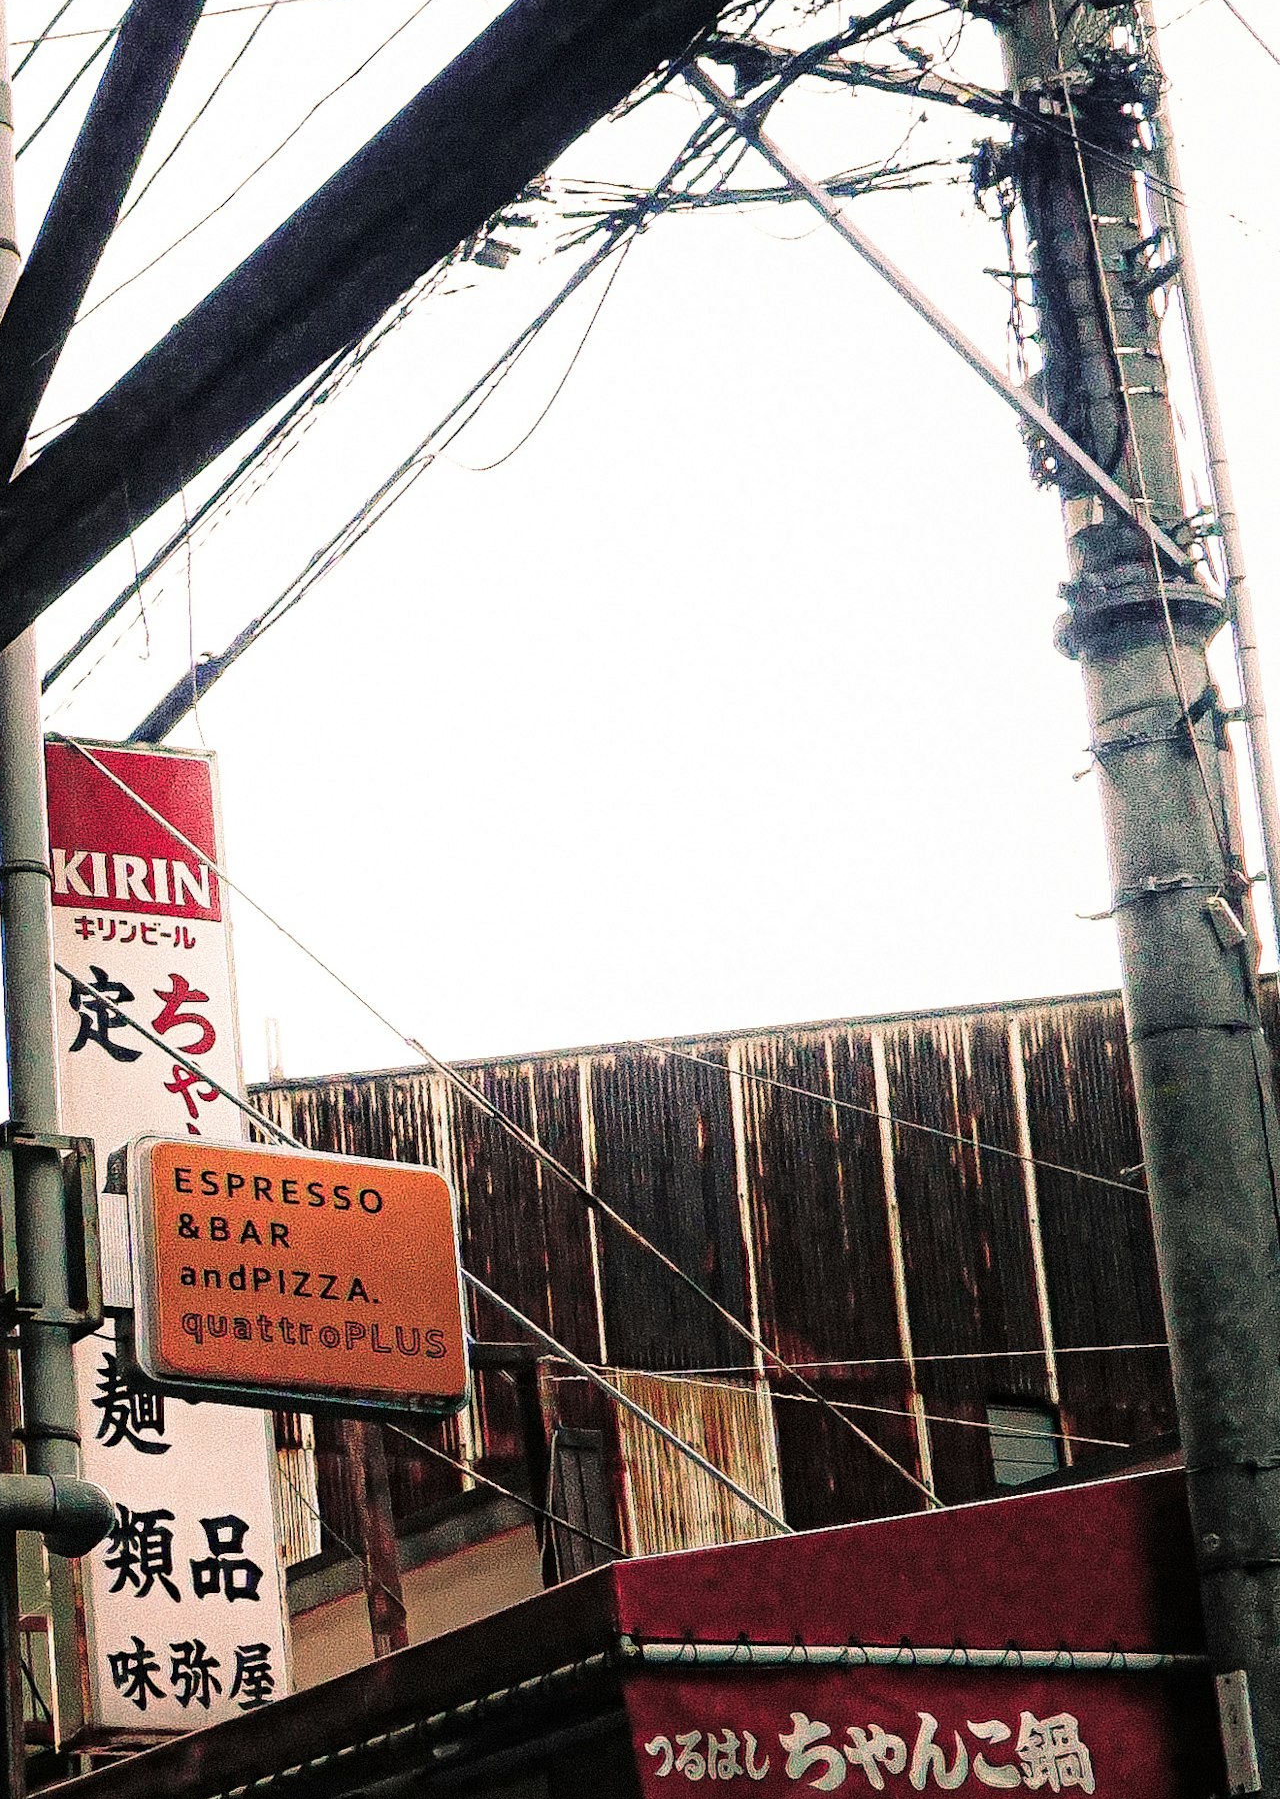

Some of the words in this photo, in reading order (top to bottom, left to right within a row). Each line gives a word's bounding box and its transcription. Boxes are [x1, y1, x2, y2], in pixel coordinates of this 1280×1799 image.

[52, 847, 212, 908] KIRIN
[74, 916, 197, 949] キリンビール
[174, 1167, 384, 1214] ESPRESSO
[178, 1217, 291, 1248] &BAR
[179, 1263, 380, 1304] andPIZZA.
[181, 1310, 447, 1359] quattroPLUS
[107, 1636, 275, 1711] 味弥屋
[644, 1728, 771, 1782] つるはし
[778, 1710, 1096, 1794] ちゃんこ鍋
